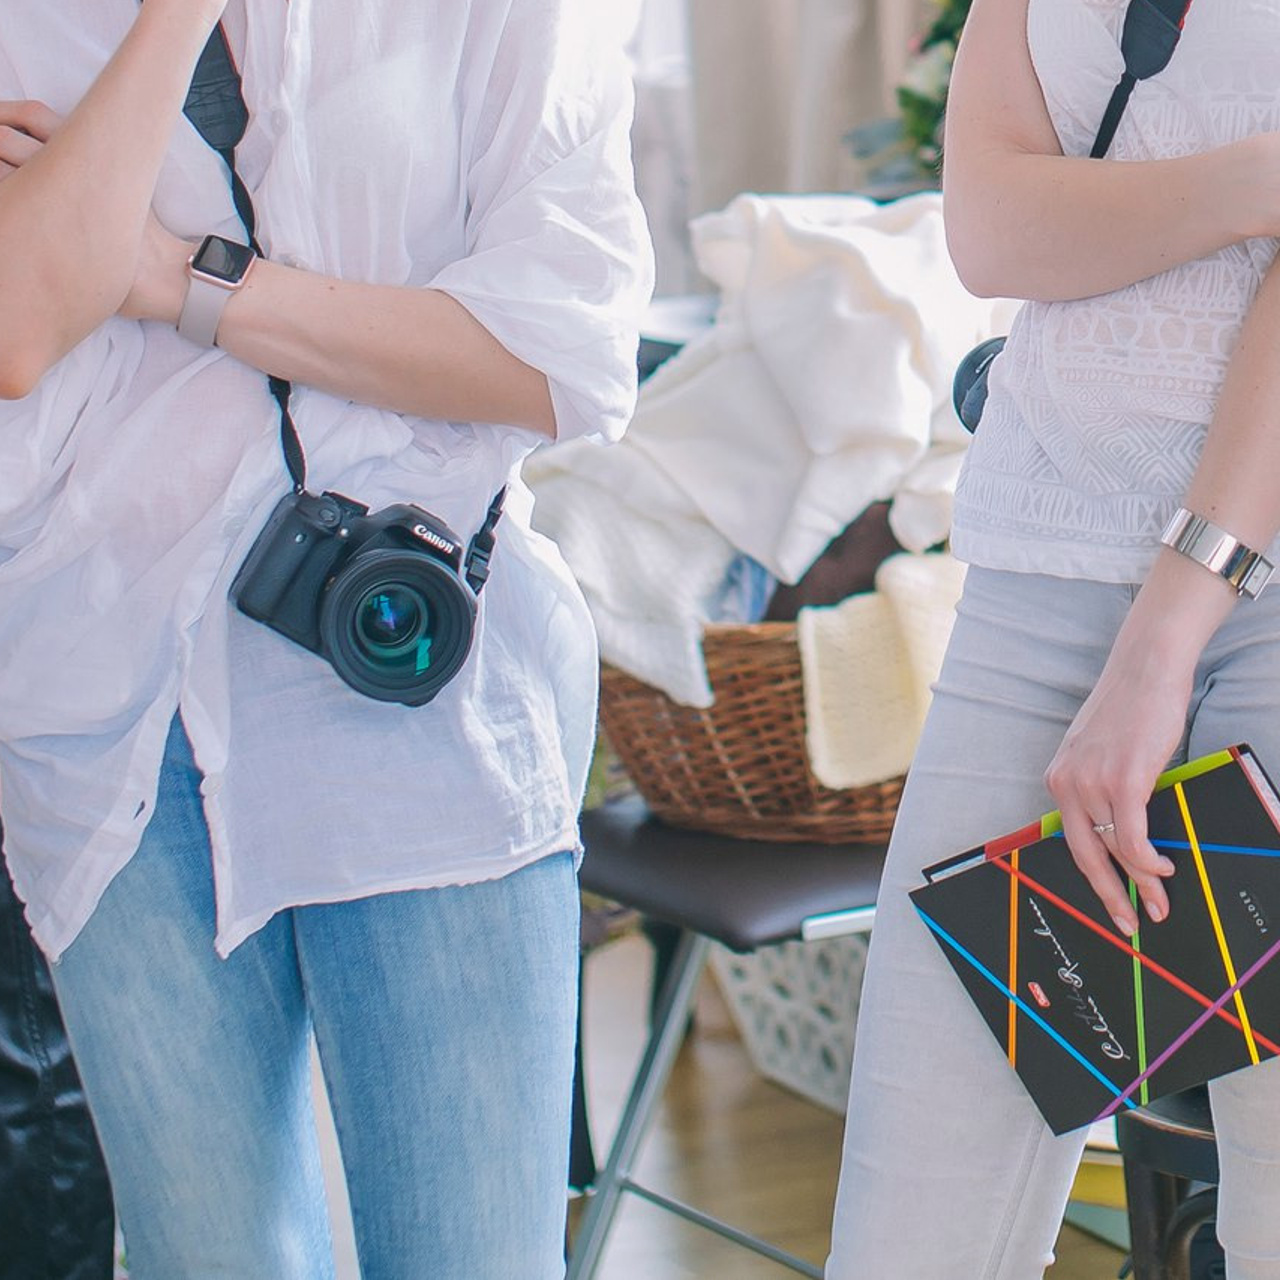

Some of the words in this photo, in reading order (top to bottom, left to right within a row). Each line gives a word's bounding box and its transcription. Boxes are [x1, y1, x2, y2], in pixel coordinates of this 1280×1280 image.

[413, 524, 455, 554] Canon
[1239, 891, 1268, 934] FOLDER
[1028, 897, 1083, 989] Rainbow
